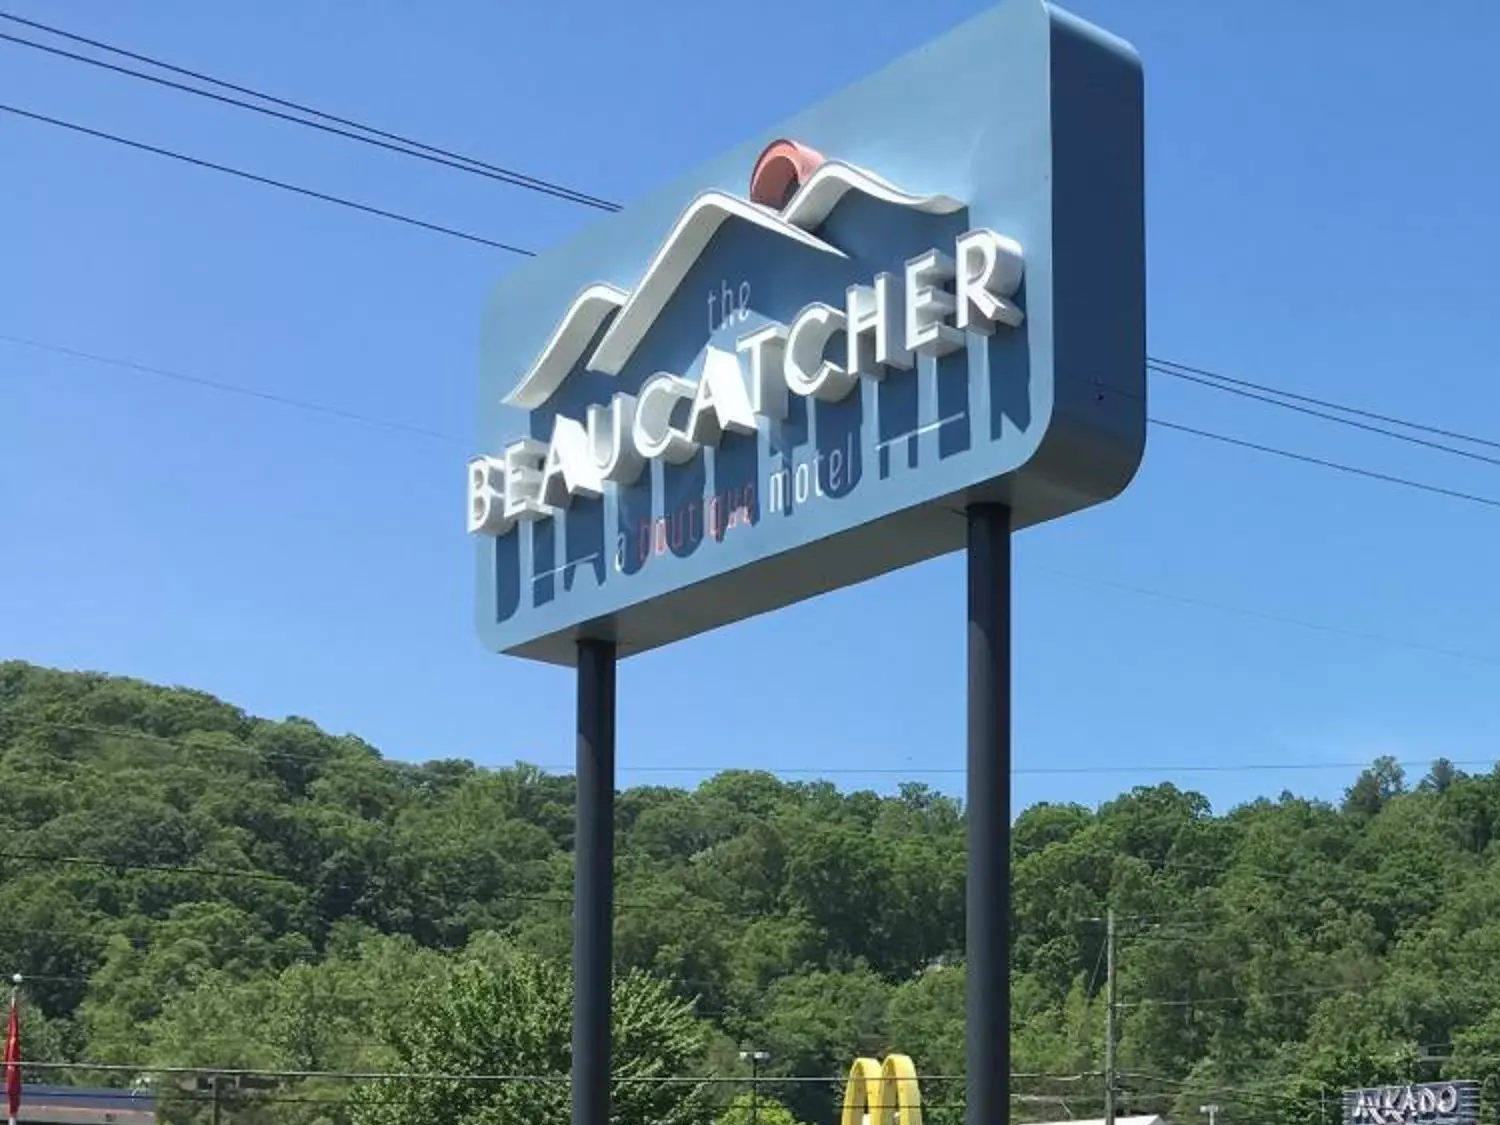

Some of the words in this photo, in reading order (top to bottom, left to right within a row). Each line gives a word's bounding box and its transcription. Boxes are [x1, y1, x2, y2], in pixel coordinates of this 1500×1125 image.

[706, 279, 750, 335] the
[466, 228, 1023, 535] BEAUCATCHER
[614, 530, 627, 573] a
[768, 431, 854, 514] motel
